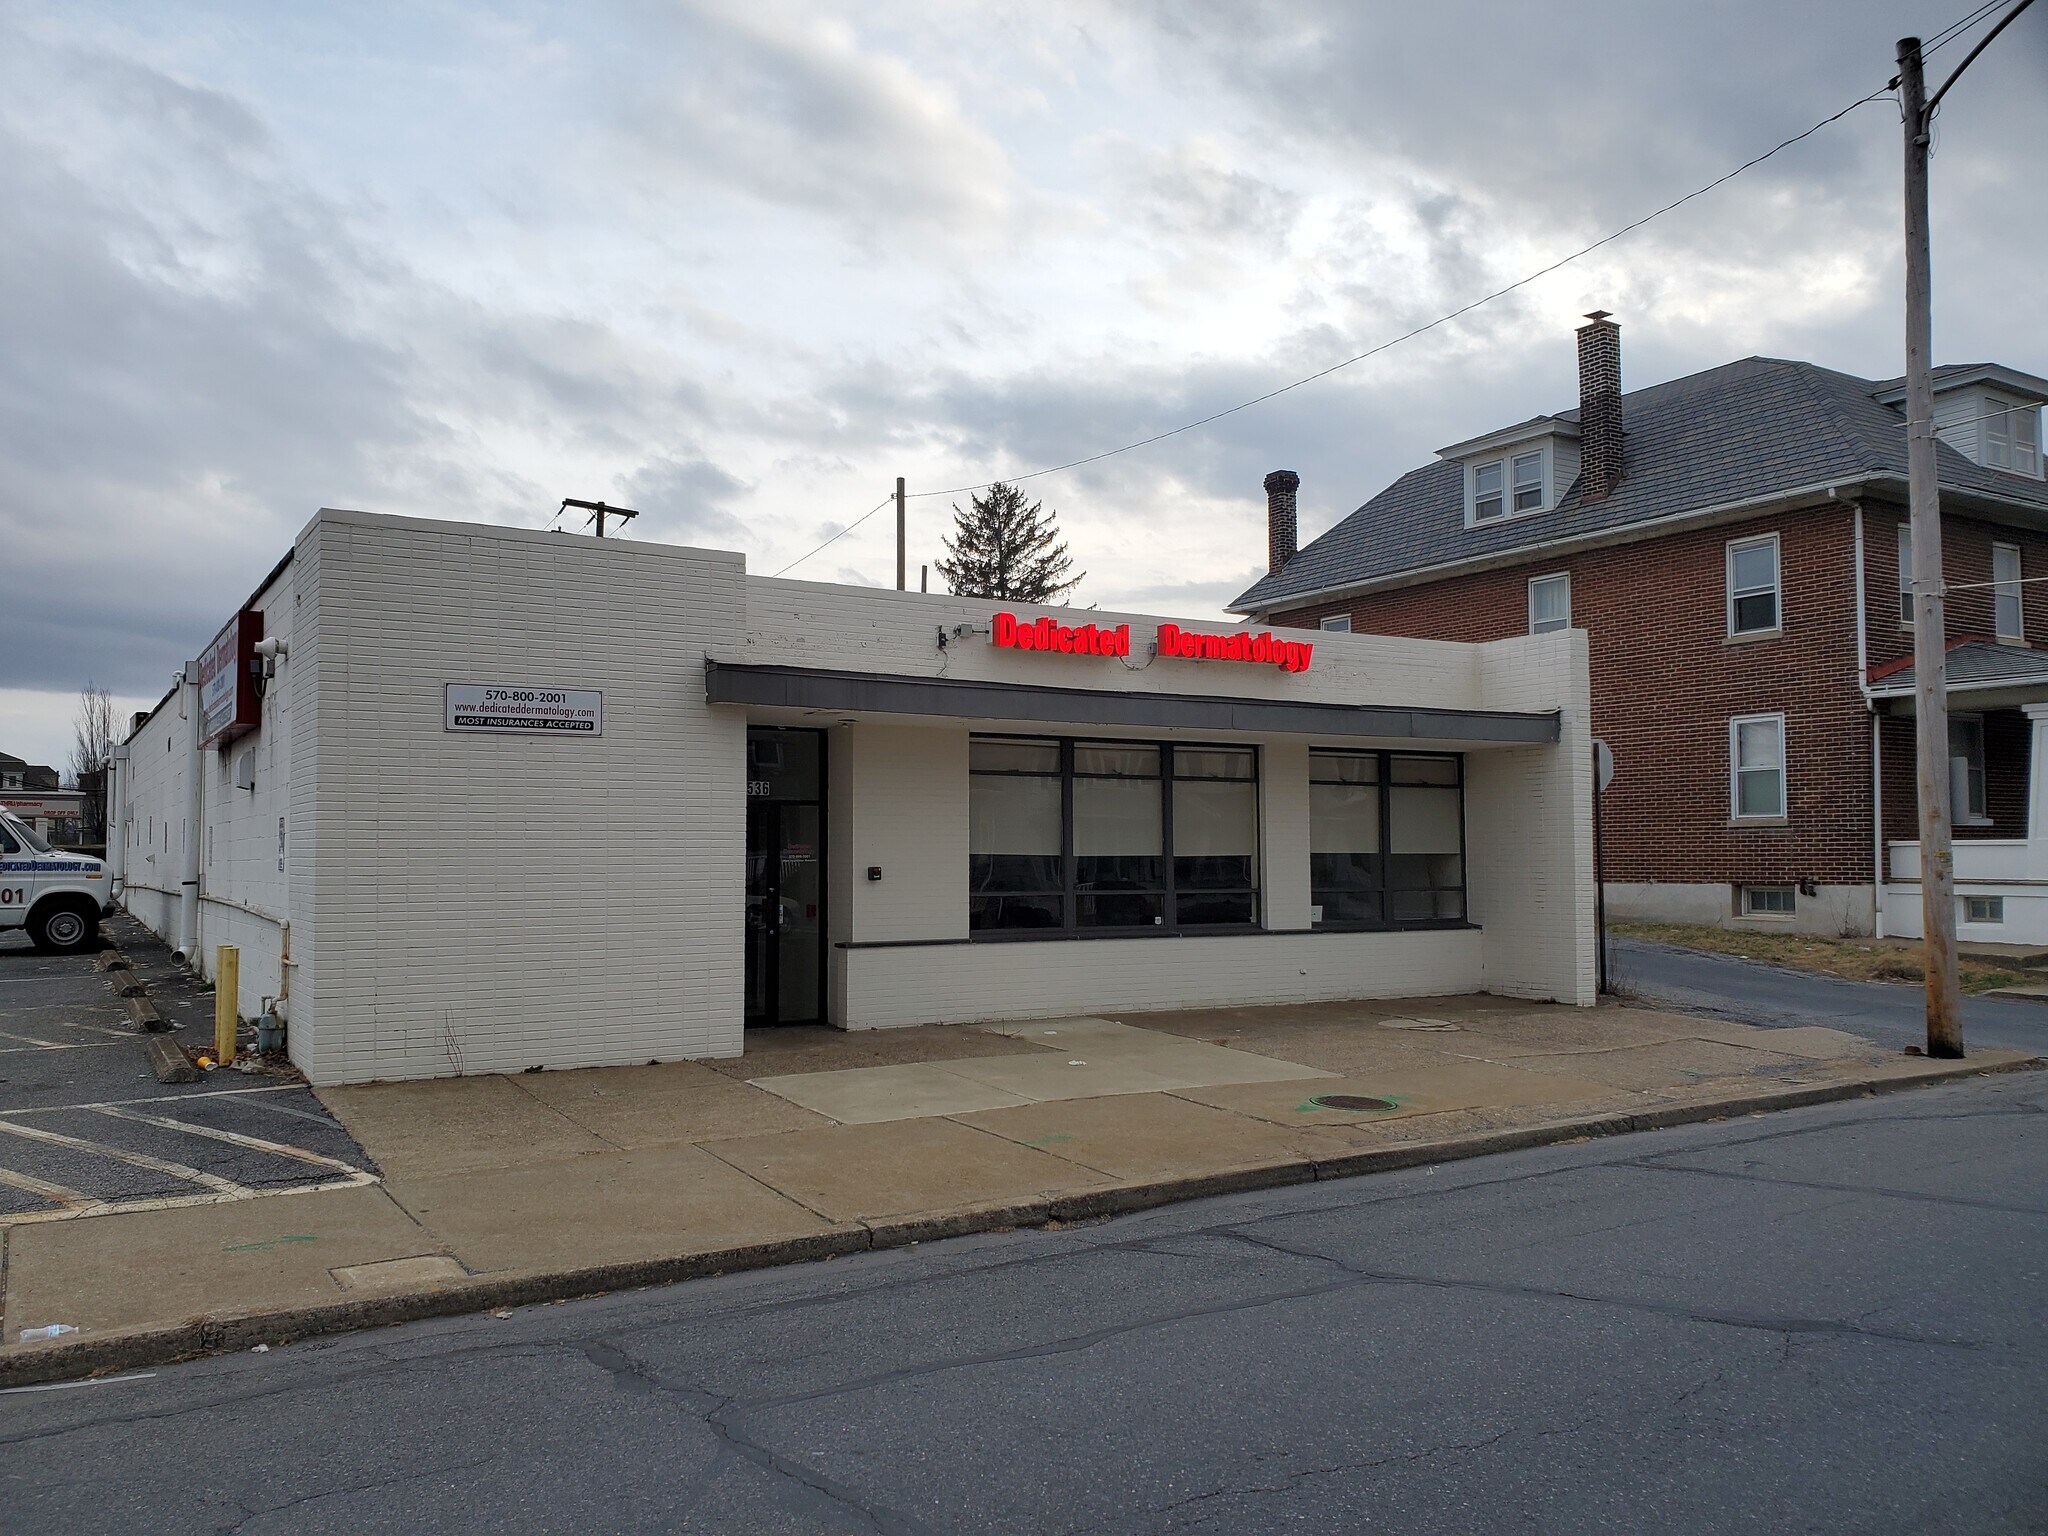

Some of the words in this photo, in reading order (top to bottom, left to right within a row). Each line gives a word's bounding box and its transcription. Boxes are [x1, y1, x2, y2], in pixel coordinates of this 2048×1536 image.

[992, 612, 1130, 657] Dedicated
[1157, 623, 1314, 674] Dermatology
[485, 690, 567, 704] 570-800-2001
[454, 701, 595, 719] www.dedicateddermatology.com
[457, 717, 486, 726] MOST
[486, 718, 544, 728] INSURANCES
[545, 720, 592, 730] ACCEPTED
[747, 782, 769, 795] 536
[1, 888, 24, 904] 01
